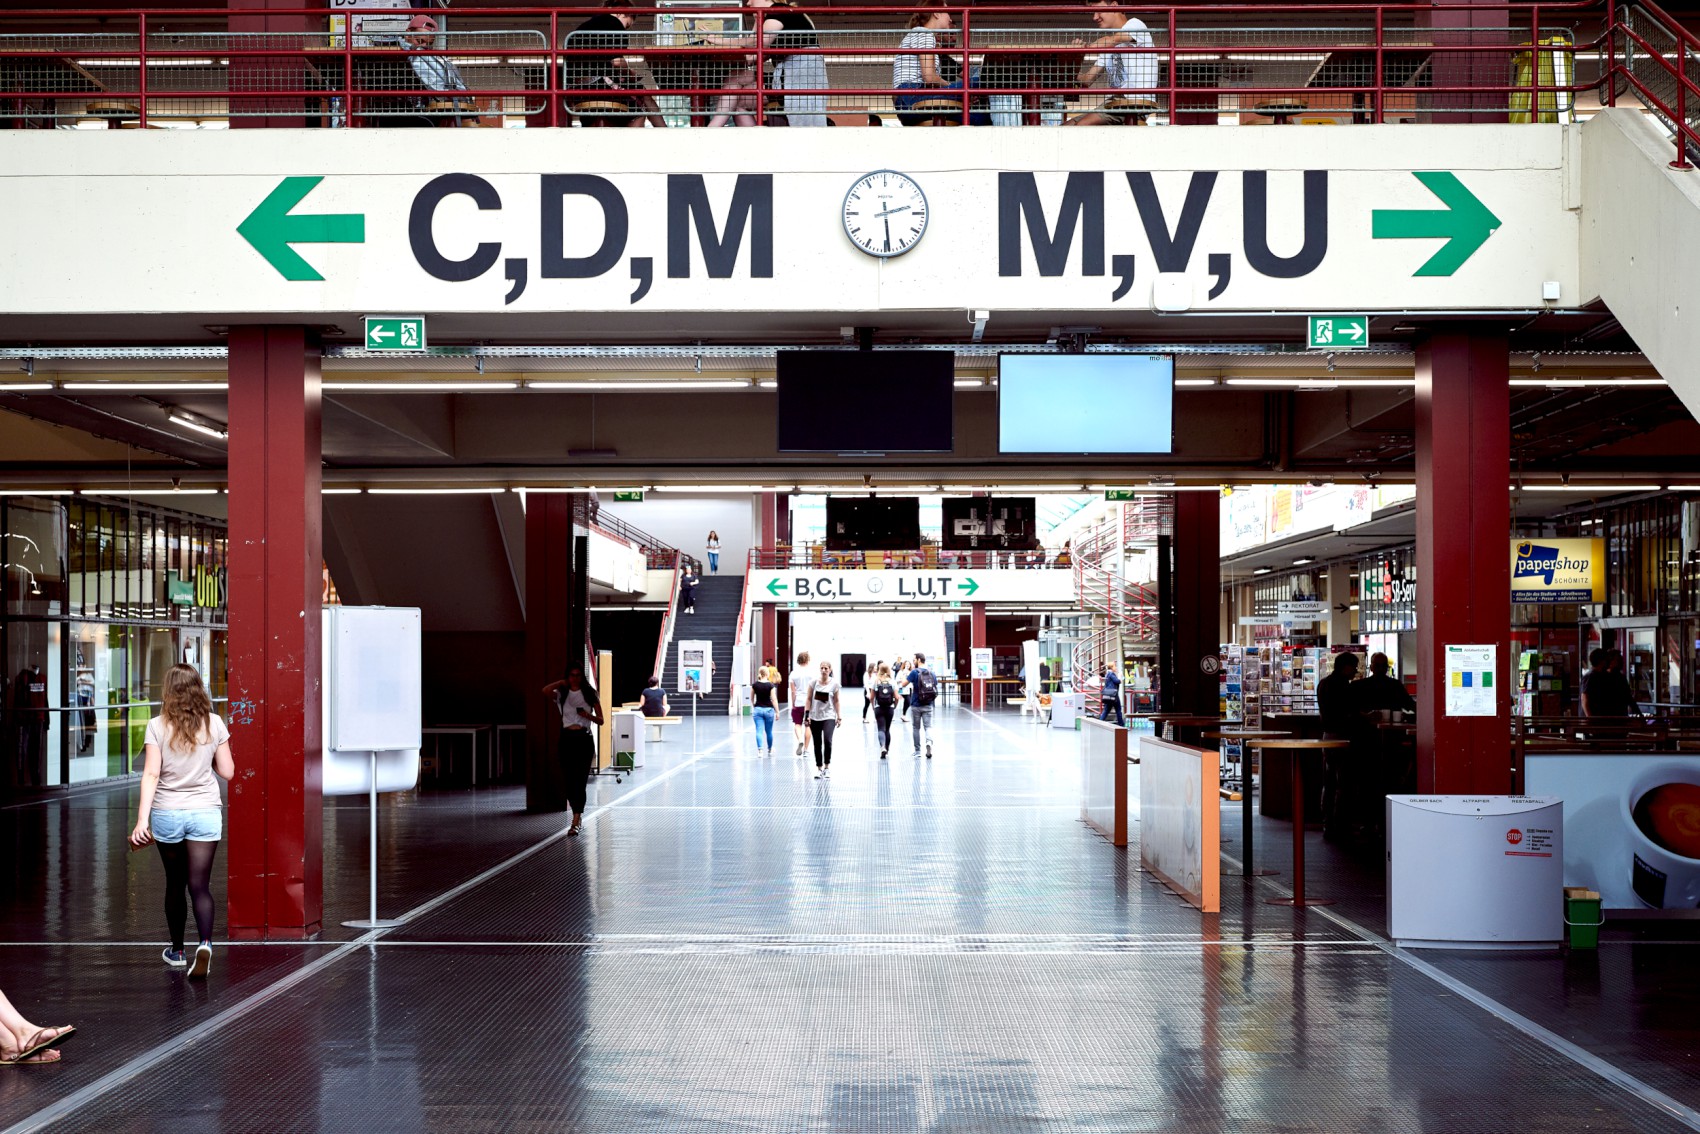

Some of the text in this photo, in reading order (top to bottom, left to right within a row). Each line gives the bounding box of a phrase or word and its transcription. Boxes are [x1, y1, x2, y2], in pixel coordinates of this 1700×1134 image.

[408, 172, 774, 305] C,D,M
[998, 170, 1328, 302] M,V,U
[1517, 557, 1589, 573] papershop
[795, 577, 852, 599] B,C,L
[898, 577, 952, 600] L,U,T
[1506, 832, 1522, 841] STOP
